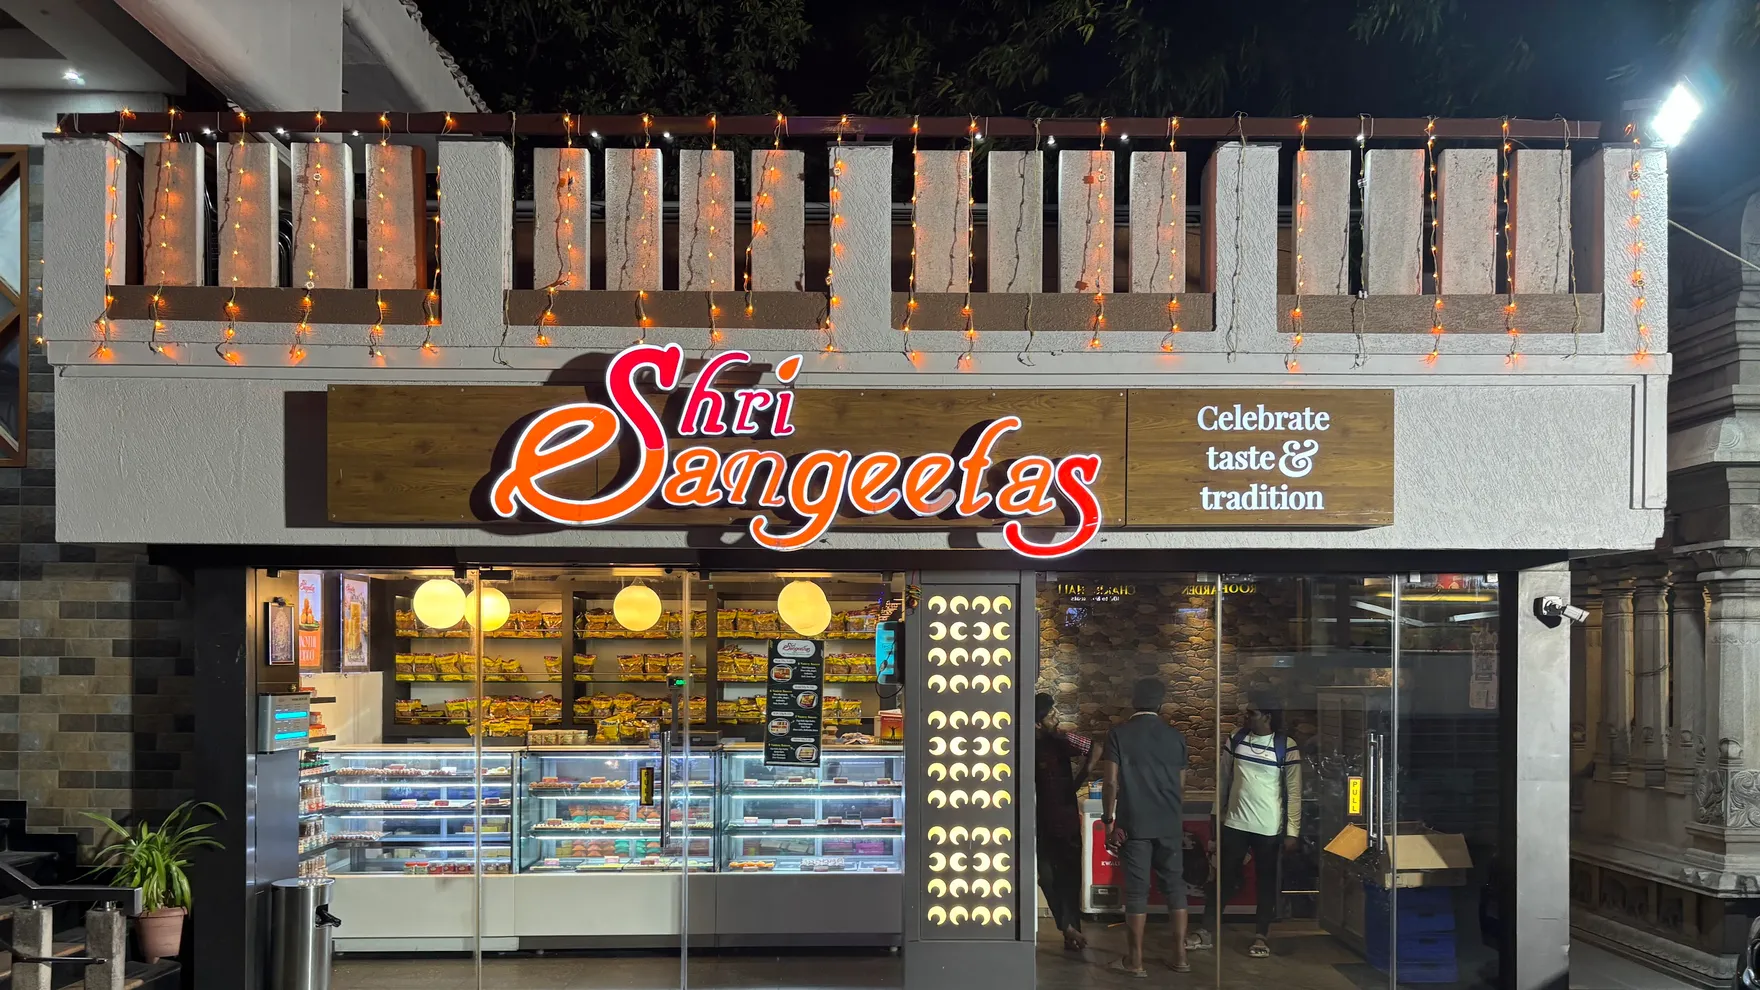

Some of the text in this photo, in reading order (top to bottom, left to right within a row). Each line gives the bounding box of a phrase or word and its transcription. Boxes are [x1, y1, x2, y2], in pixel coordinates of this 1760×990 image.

[605, 343, 803, 450] Shri
[1197, 403, 1330, 431] Celebrate
[491, 343, 1102, 559] Sangeetas
[1206, 439, 1319, 478] taste &
[1200, 483, 1325, 511] tradition
